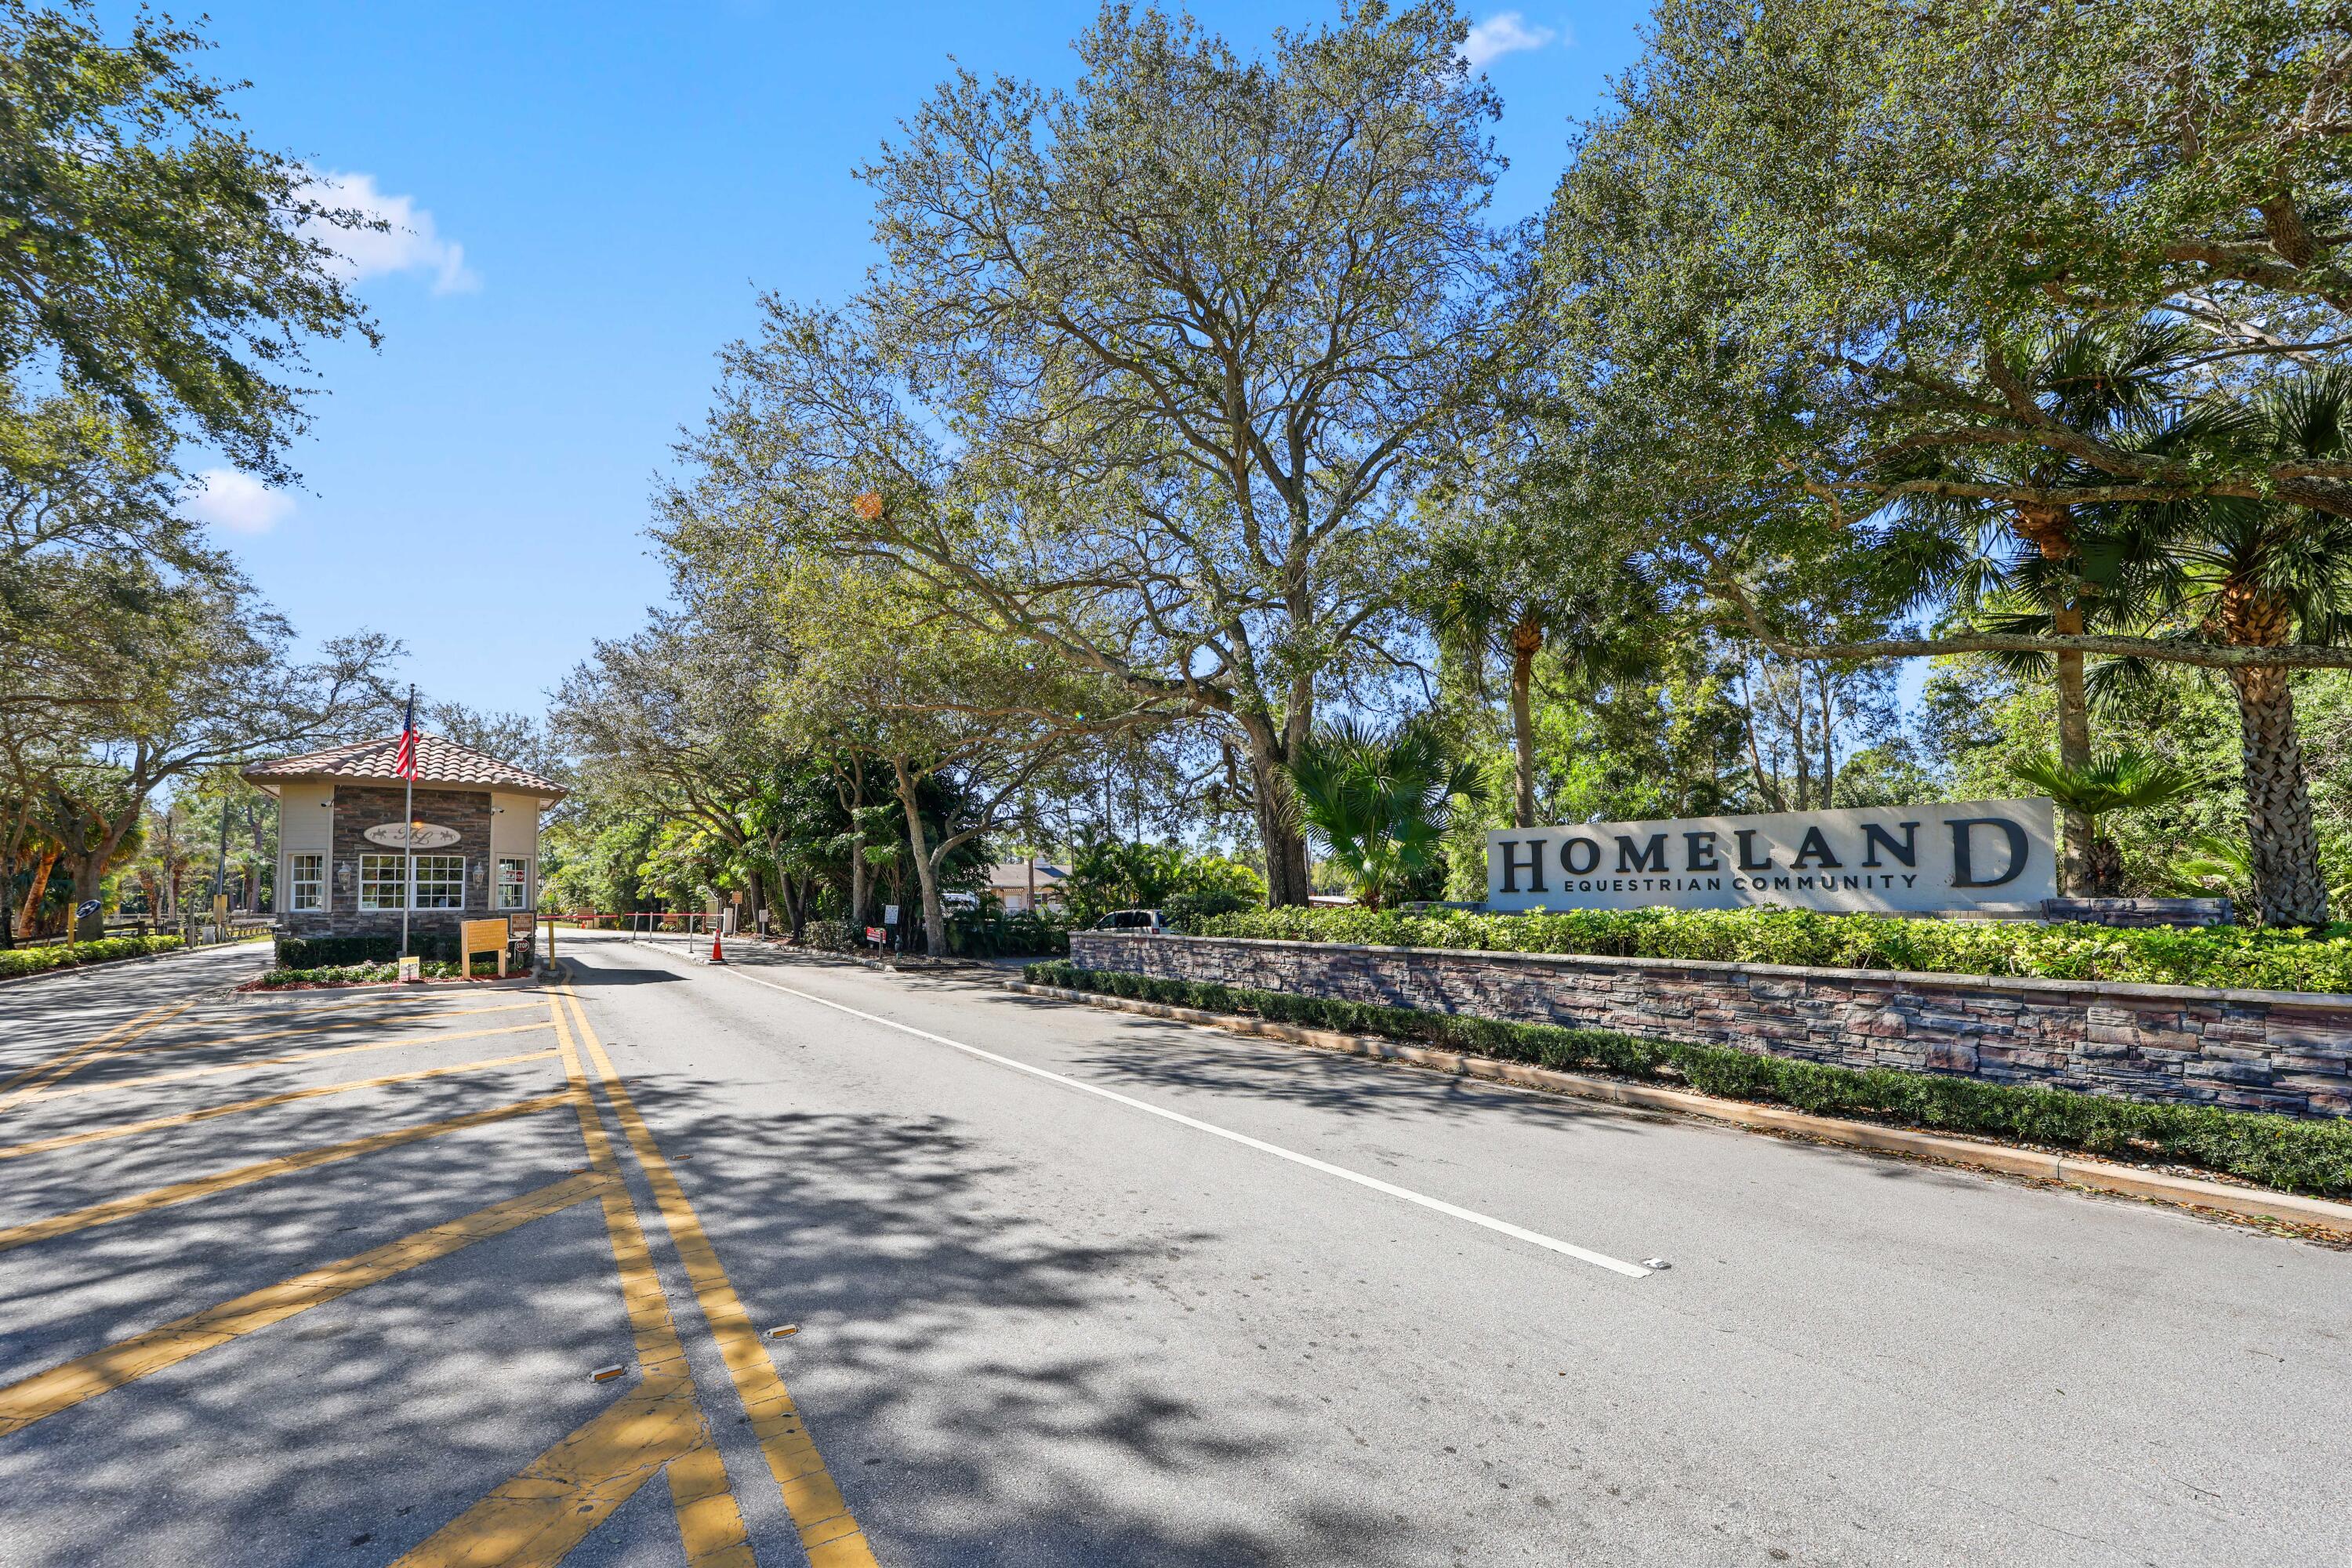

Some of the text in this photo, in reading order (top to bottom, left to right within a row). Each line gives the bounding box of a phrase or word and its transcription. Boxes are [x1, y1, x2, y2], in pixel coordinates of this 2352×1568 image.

[1497, 818, 2029, 893] HOMELAND
[1564, 874, 1918, 892] EQUESTRIAN COMMUNITY
